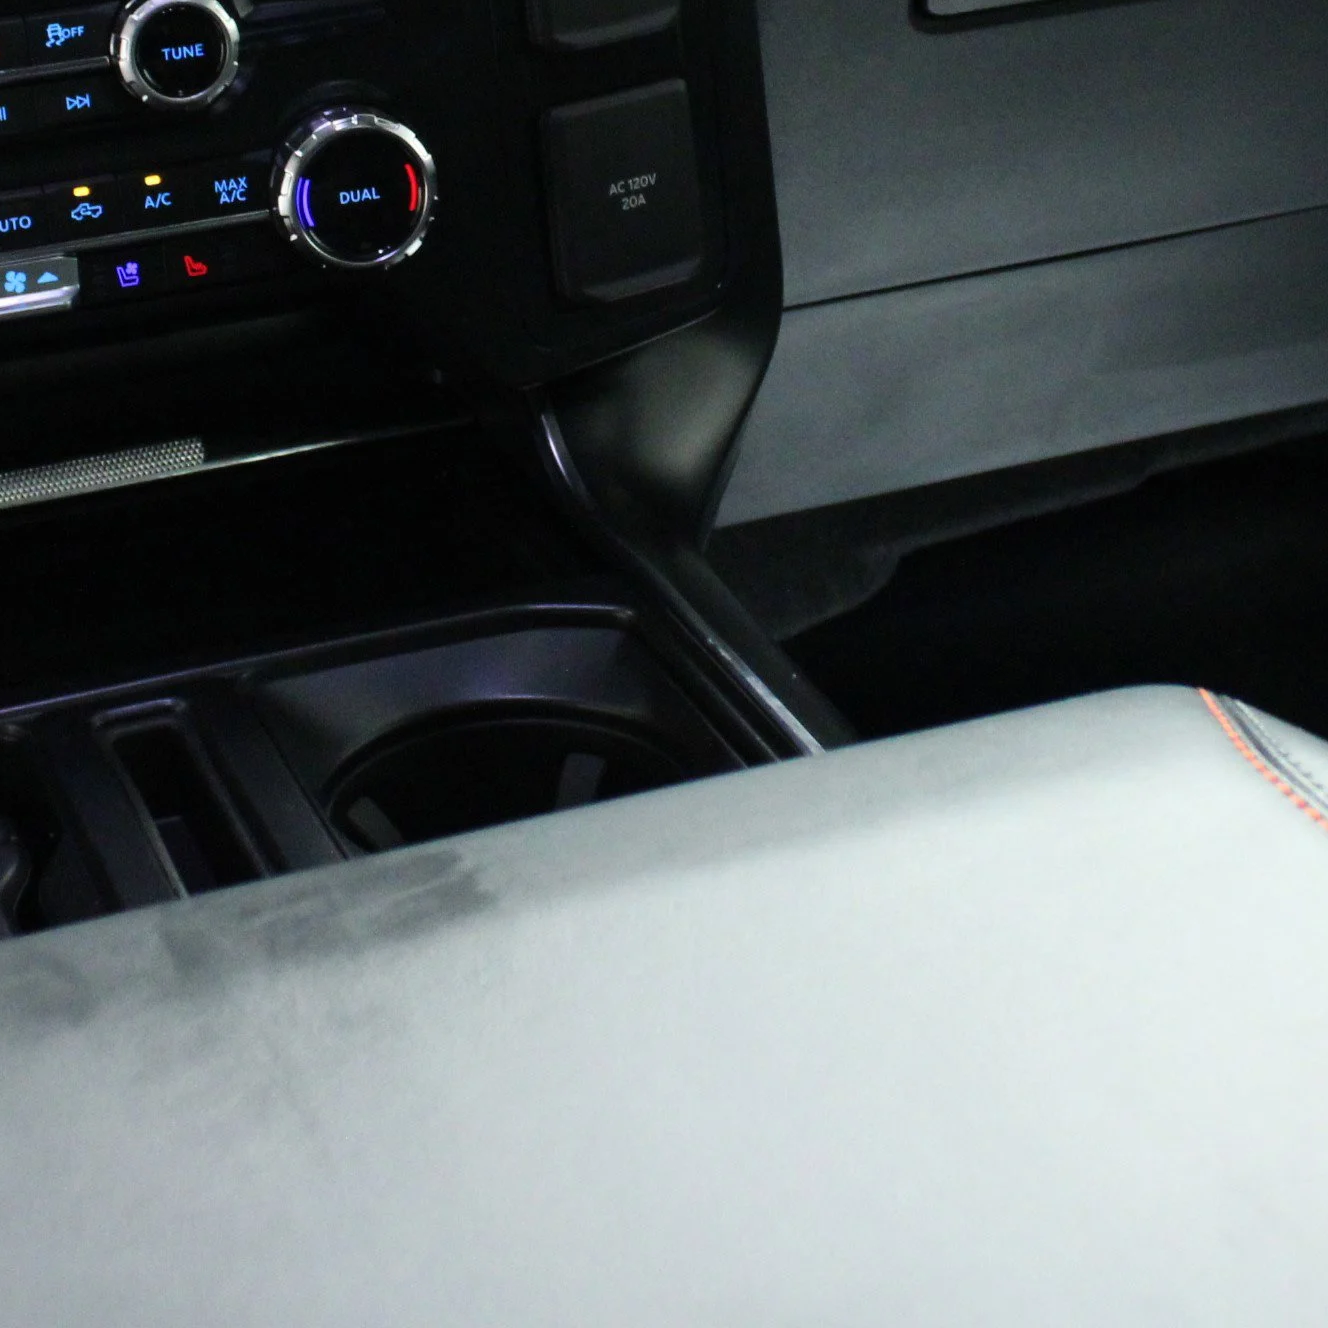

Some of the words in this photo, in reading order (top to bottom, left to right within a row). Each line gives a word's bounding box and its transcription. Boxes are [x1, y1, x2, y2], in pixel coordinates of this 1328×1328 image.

[62, 25, 85, 39] OFF
[161, 43, 205, 61] TUNE
[214, 176, 249, 193] MAX
[609, 180, 626, 196] AC
[628, 173, 657, 191] 120V
[144, 192, 172, 209] A/C
[219, 189, 247, 204] A/C
[339, 187, 381, 205] DUAL
[622, 194, 646, 211] 20A
